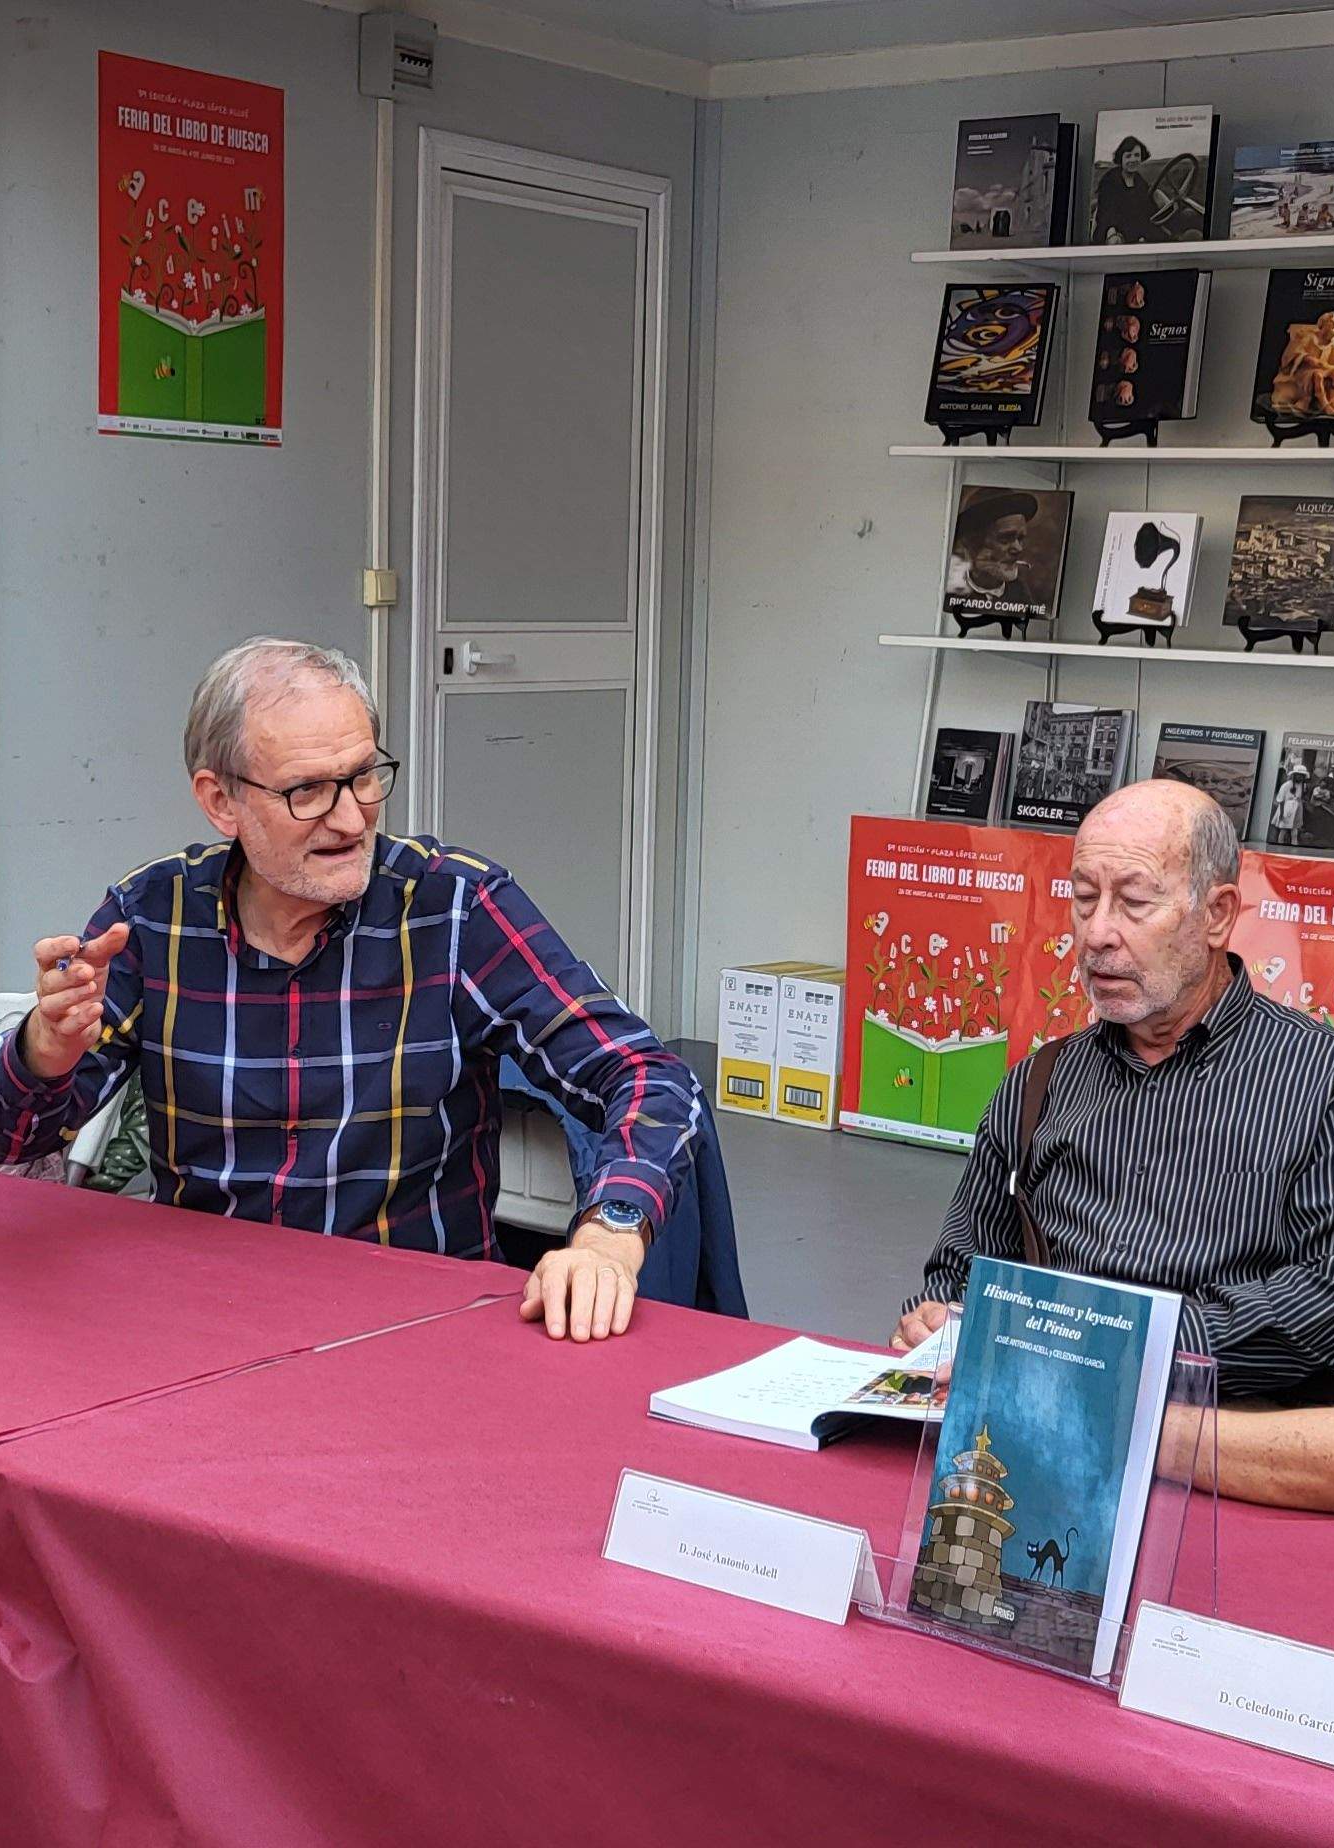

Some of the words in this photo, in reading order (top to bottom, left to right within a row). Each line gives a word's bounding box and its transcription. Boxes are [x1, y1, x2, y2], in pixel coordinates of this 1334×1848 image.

[118, 106, 149, 131] FERIA
[153, 112, 173, 136] DEL
[176, 117, 208, 142] LIBRO
[211, 124, 224, 146] DE
[228, 127, 269, 154] HUESCA
[1149, 323, 1187, 340] Signos
[1165, 728, 1204, 738] INGENIEROS
[1211, 731, 1255, 742] FOTÓGRAFOS
[1287, 737, 1323, 746] FELICIANO
[1017, 805, 1064, 820] SKOGLER
[930, 848, 954, 857] PLAZA
[955, 849, 977, 859] LÓPEZ
[979, 853, 1004, 862] ALLUÉ
[866, 859, 897, 879] FERIA
[899, 862, 920, 881] DEL
[922, 864, 955, 885] LIBRO
[958, 868, 973, 887] DE
[975, 870, 1025, 893] HUESCA
[1298, 886, 1332, 897] EDICIÓN
[1259, 899, 1300, 922] FERIA
[1303, 904, 1329, 925] DEL
[728, 1000, 768, 1015] ENATE
[787, 1009, 828, 1024] ENATE
[983, 1283, 1034, 1309] Historias,
[1036, 1299, 1076, 1318] cuentos
[1075, 1309, 1085, 1322] y
[1085, 1307, 1134, 1331] leyendas
[1025, 1316, 1043, 1331] del
[1043, 1319, 1082, 1341] Pirineo
[994, 1335, 1010, 1346] JOSÉ
[1009, 1338, 1033, 1352] ANTONIO
[1032, 1343, 1049, 1356] ADELL
[1053, 1349, 1085, 1365] CELEDONIO
[1084, 1357, 1105, 1371] GARCÍA
[678, 1543, 689, 1555] D.
[691, 1546, 712, 1561] José
[712, 1552, 750, 1572] Antonio
[751, 1563, 778, 1580] Adell
[993, 1605, 1015, 1622] PIRINEO
[1219, 1691, 1232, 1706] D.
[1235, 1696, 1295, 1722] Celedonio
